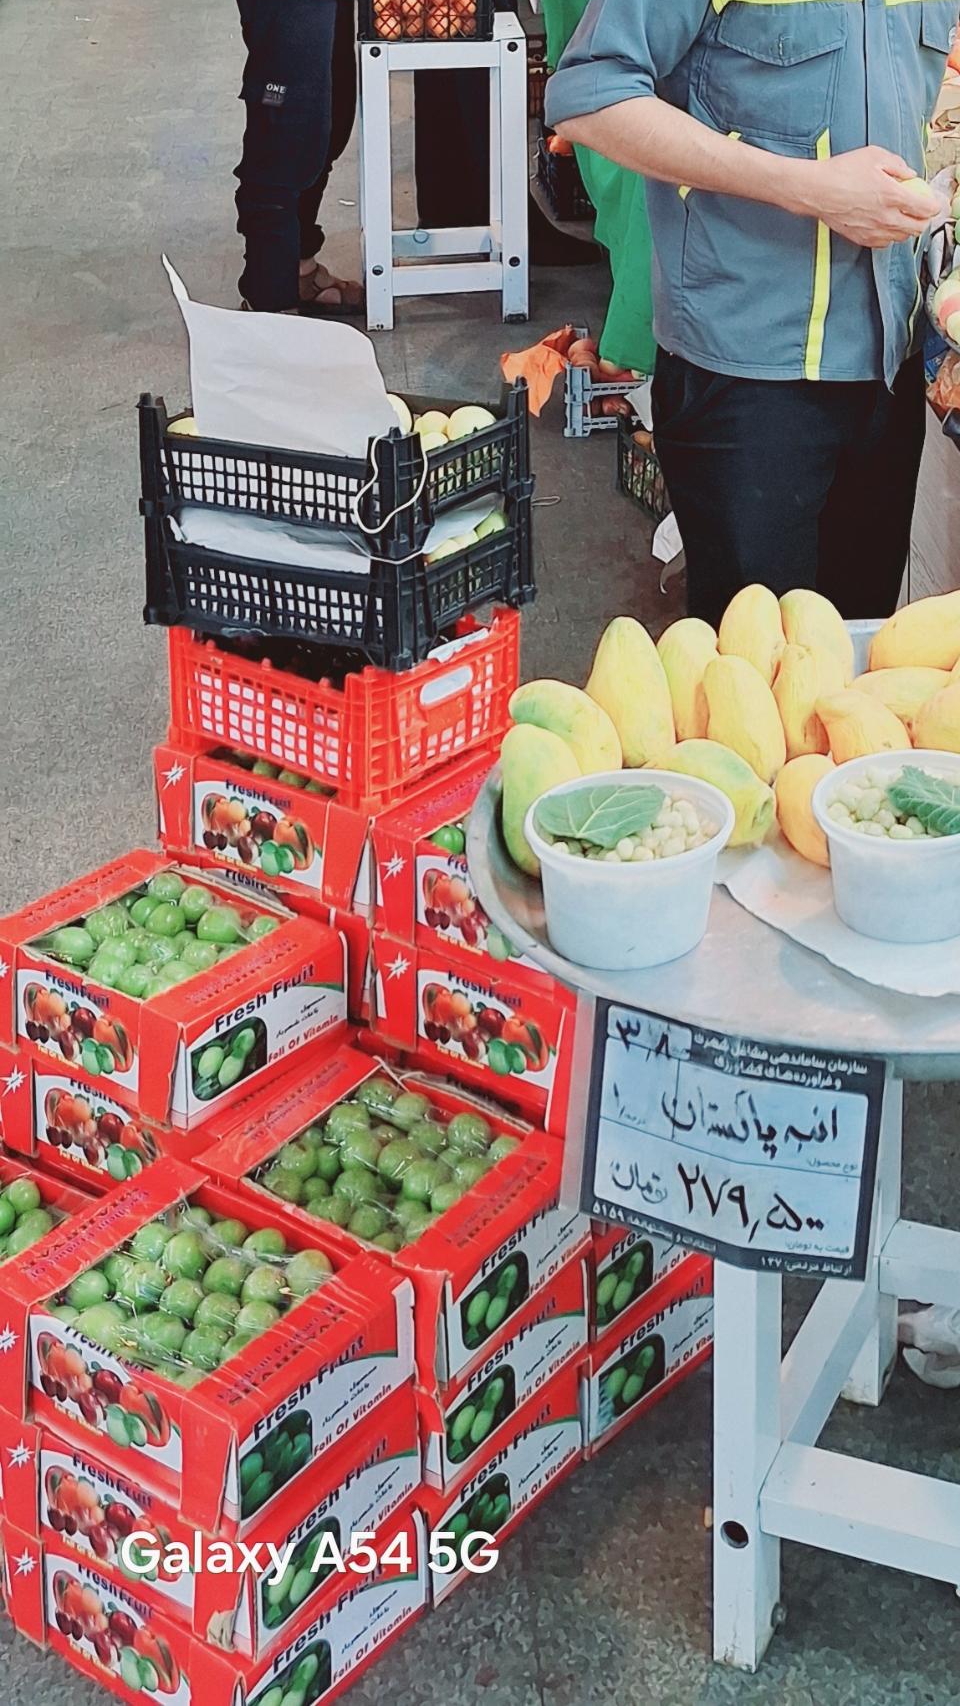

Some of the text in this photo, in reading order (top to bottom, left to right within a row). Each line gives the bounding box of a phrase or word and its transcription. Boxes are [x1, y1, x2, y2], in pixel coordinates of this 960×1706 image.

[266, 84, 286, 94] ONE
[46, 969, 80, 996] Fresh
[215, 996, 268, 1033] Fresh
[273, 965, 314, 997] Fruit
[731, 1042, 768, 1060] مشاغل
[769, 1050, 826, 1069] ساماندهی
[828, 1060, 868, 1075] سازمان
[661, 1086, 837, 1159] انبه پاکستان
[481, 1227, 528, 1277] Fresh
[620, 1310, 666, 1354] Fresh
[253, 1335, 365, 1441] Fresh Fruit
[467, 1341, 514, 1392] Fresh
[73, 1452, 113, 1485] Fresh
[460, 1404, 551, 1503] Fresh Fruit
[287, 1437, 387, 1544] Fresh Fruit
[79, 1562, 118, 1594] Fresh
[273, 1612, 331, 1674] Fresh
